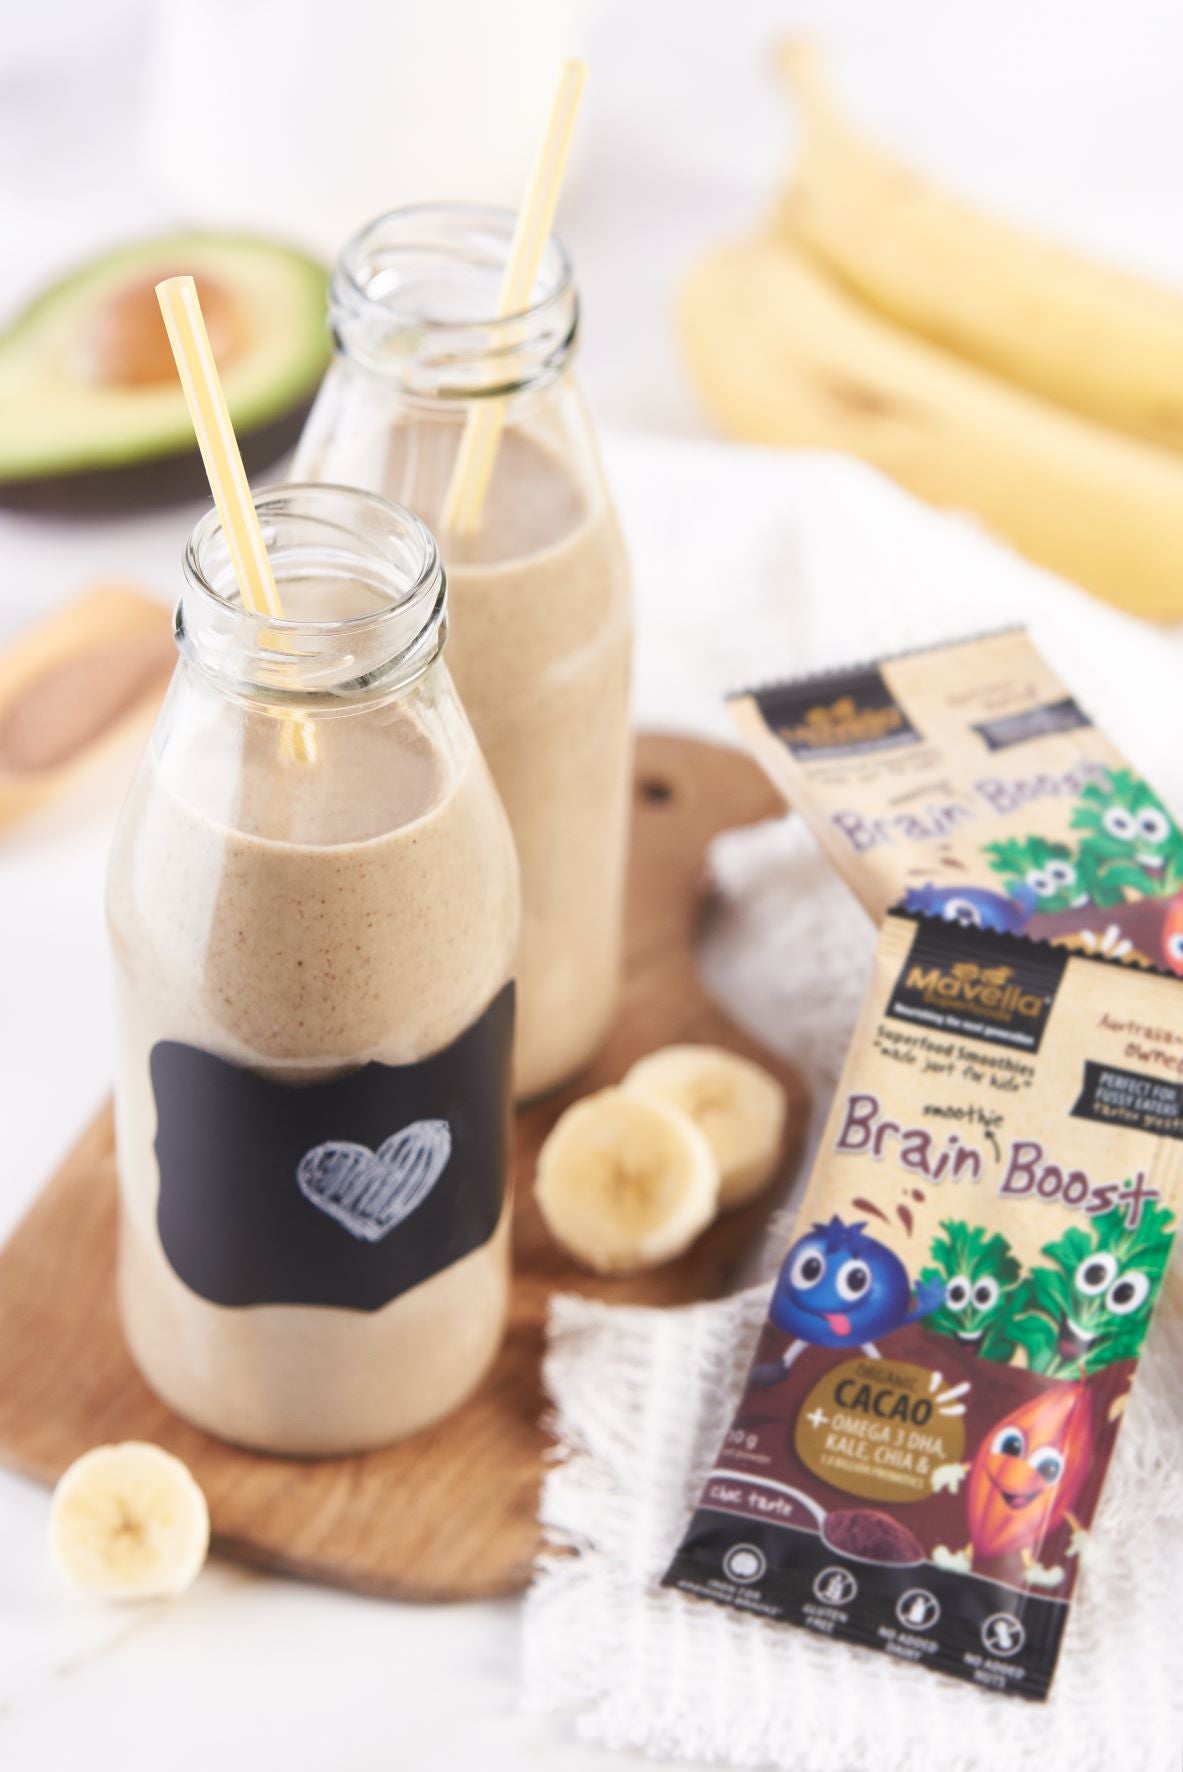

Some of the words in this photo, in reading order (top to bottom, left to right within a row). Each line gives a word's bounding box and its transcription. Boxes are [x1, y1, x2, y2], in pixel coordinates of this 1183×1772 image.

[832, 801, 976, 854] Brain
[906, 964, 1043, 1017] Mavella
[836, 1093, 982, 1180] Brain
[1000, 1140, 1161, 1228] Boost
[833, 1378, 934, 1427] CACAO
[831, 1413, 892, 1443] OMEGA
[894, 1429, 906, 1447] 3
[873, 1445, 914, 1471] CHIA
[915, 1455, 931, 1475] &
